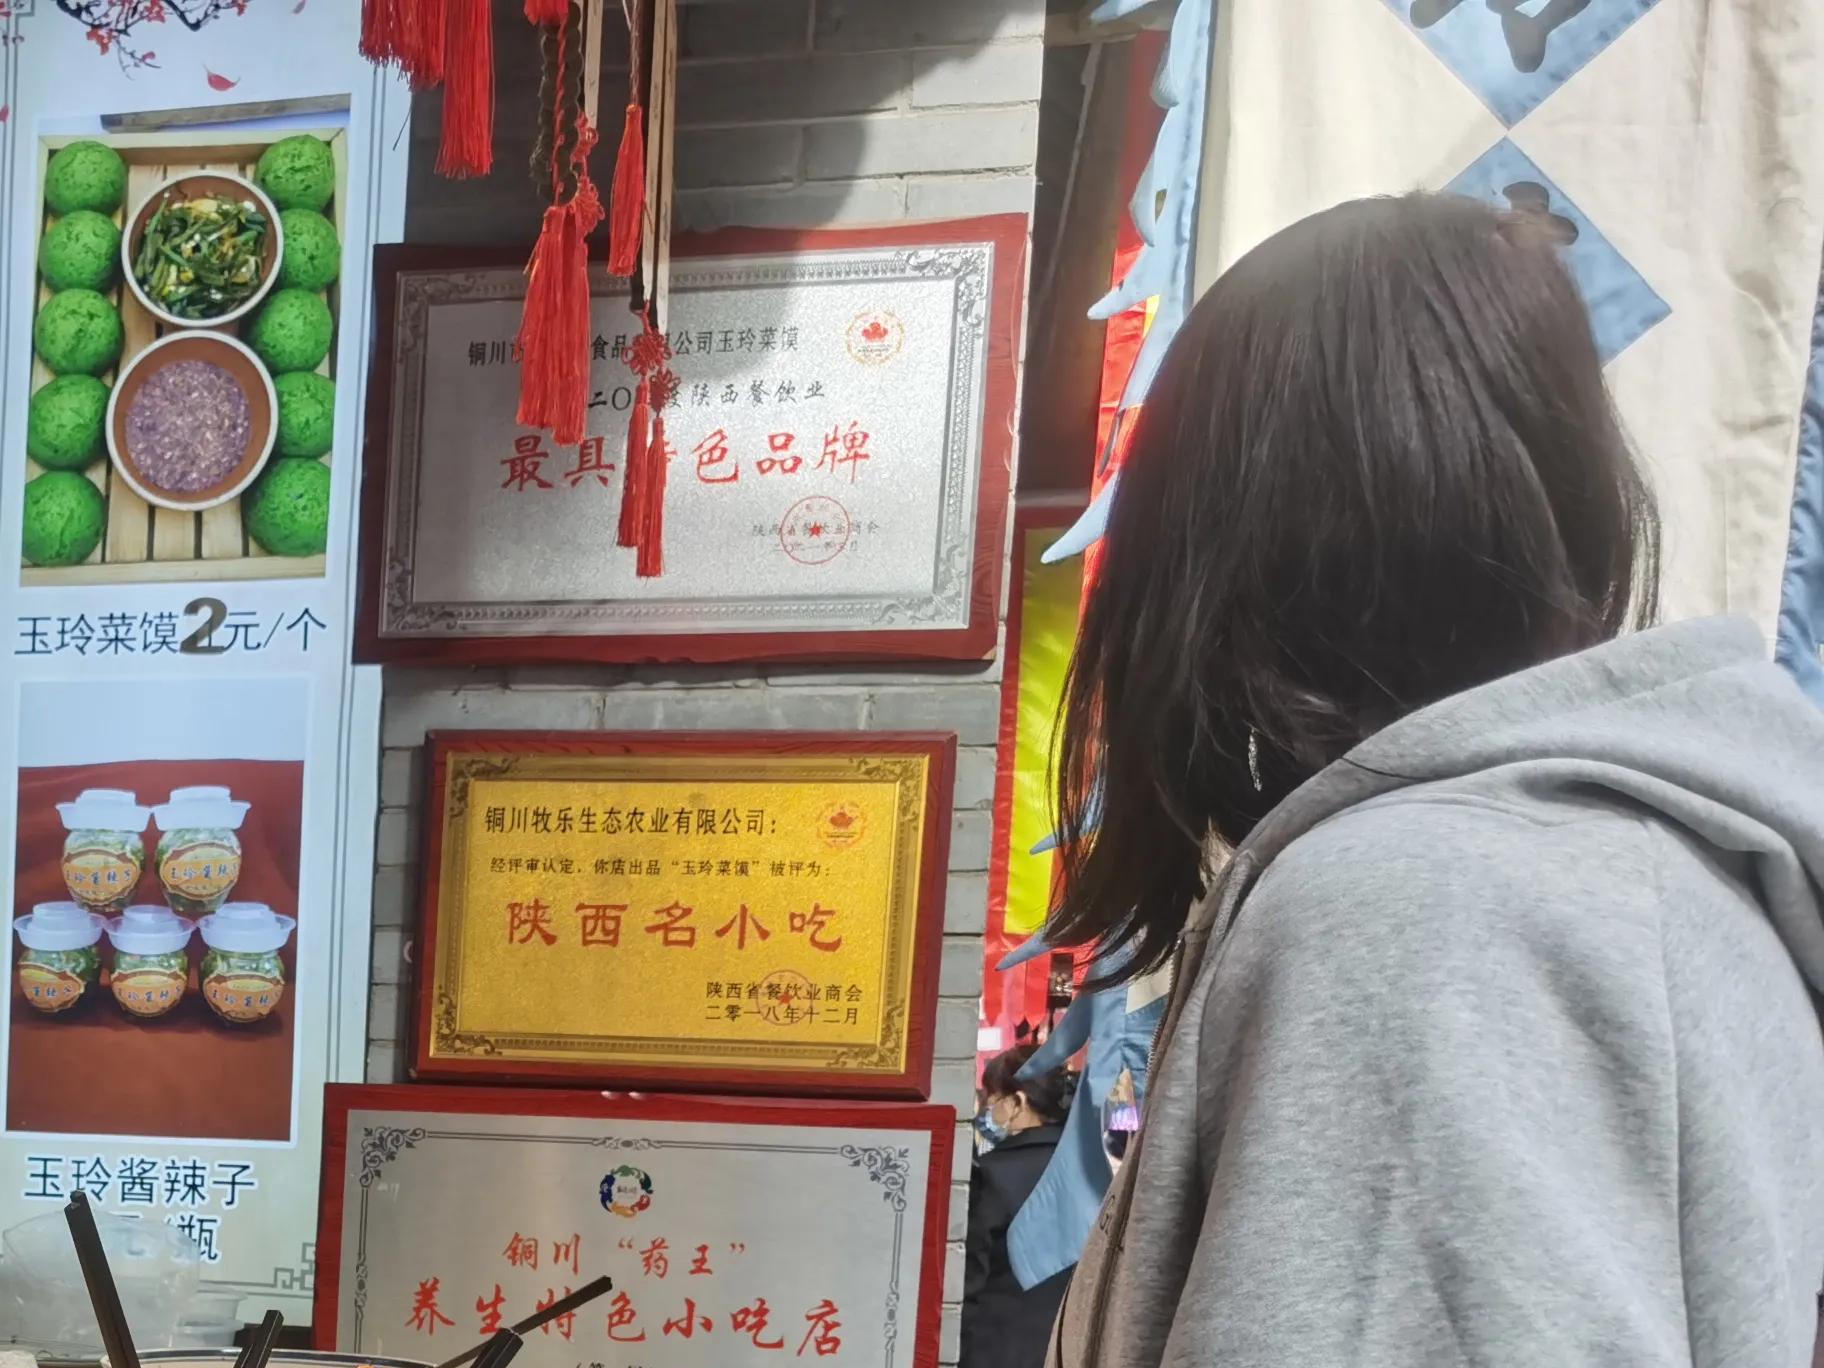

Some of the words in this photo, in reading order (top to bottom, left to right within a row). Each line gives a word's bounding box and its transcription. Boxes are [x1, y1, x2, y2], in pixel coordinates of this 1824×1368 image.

[501, 421, 870, 491] 最具色品牌
[506, 897, 843, 952] 陕西名小吃
[705, 1004, 858, 1025] 二零一八年十二月
[706, 981, 863, 1002] 陕西省餐饮业商会
[24, 1156, 255, 1206] 玉玲酱辣子
[404, 1276, 842, 1357] 养生特色小吃店
